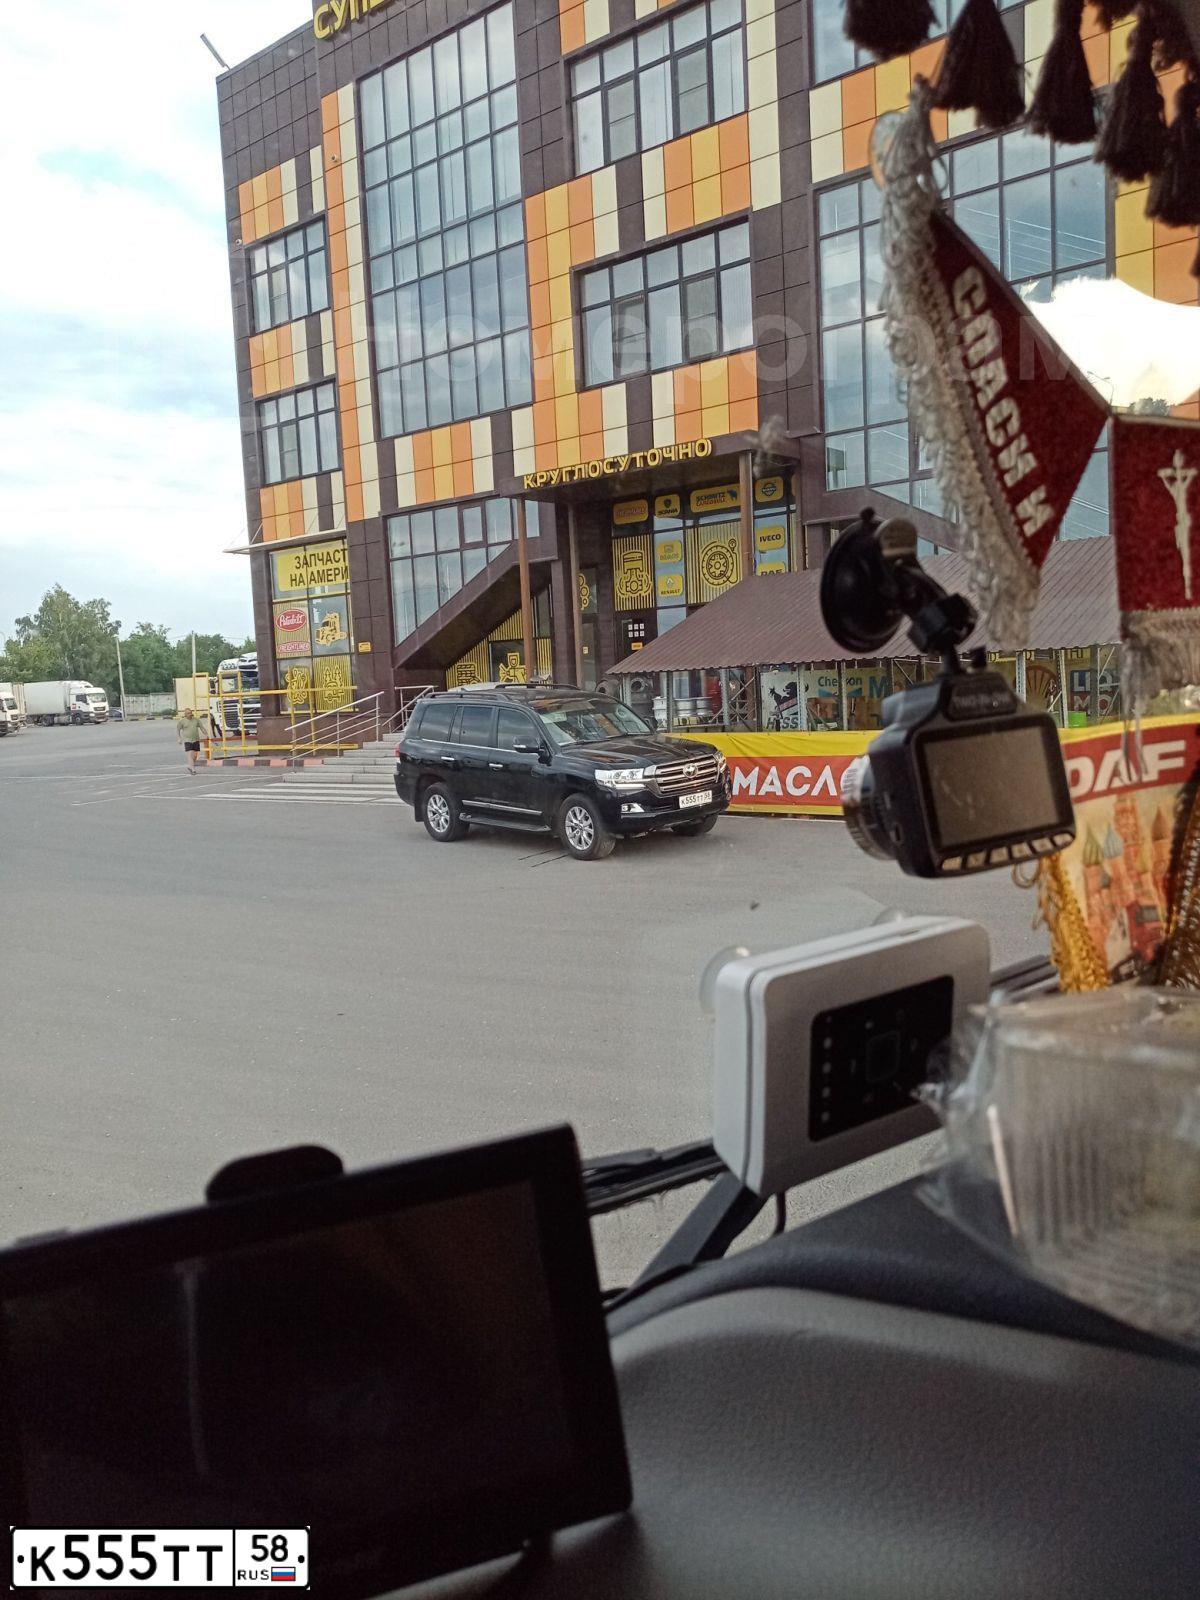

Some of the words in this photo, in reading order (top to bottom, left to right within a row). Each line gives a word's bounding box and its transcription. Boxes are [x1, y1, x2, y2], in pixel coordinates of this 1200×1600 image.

[523, 438, 712, 490] КРУГЛОСУТОЧНО
[759, 533, 782, 543] IVECO
[294, 548, 348, 570] ЗАПЧАСТ
[290, 573, 306, 587] НА
[309, 566, 349, 585] АМЕРИ
[731, 764, 846, 797] МАСЛ
[1066, 739, 1187, 799] DAF
